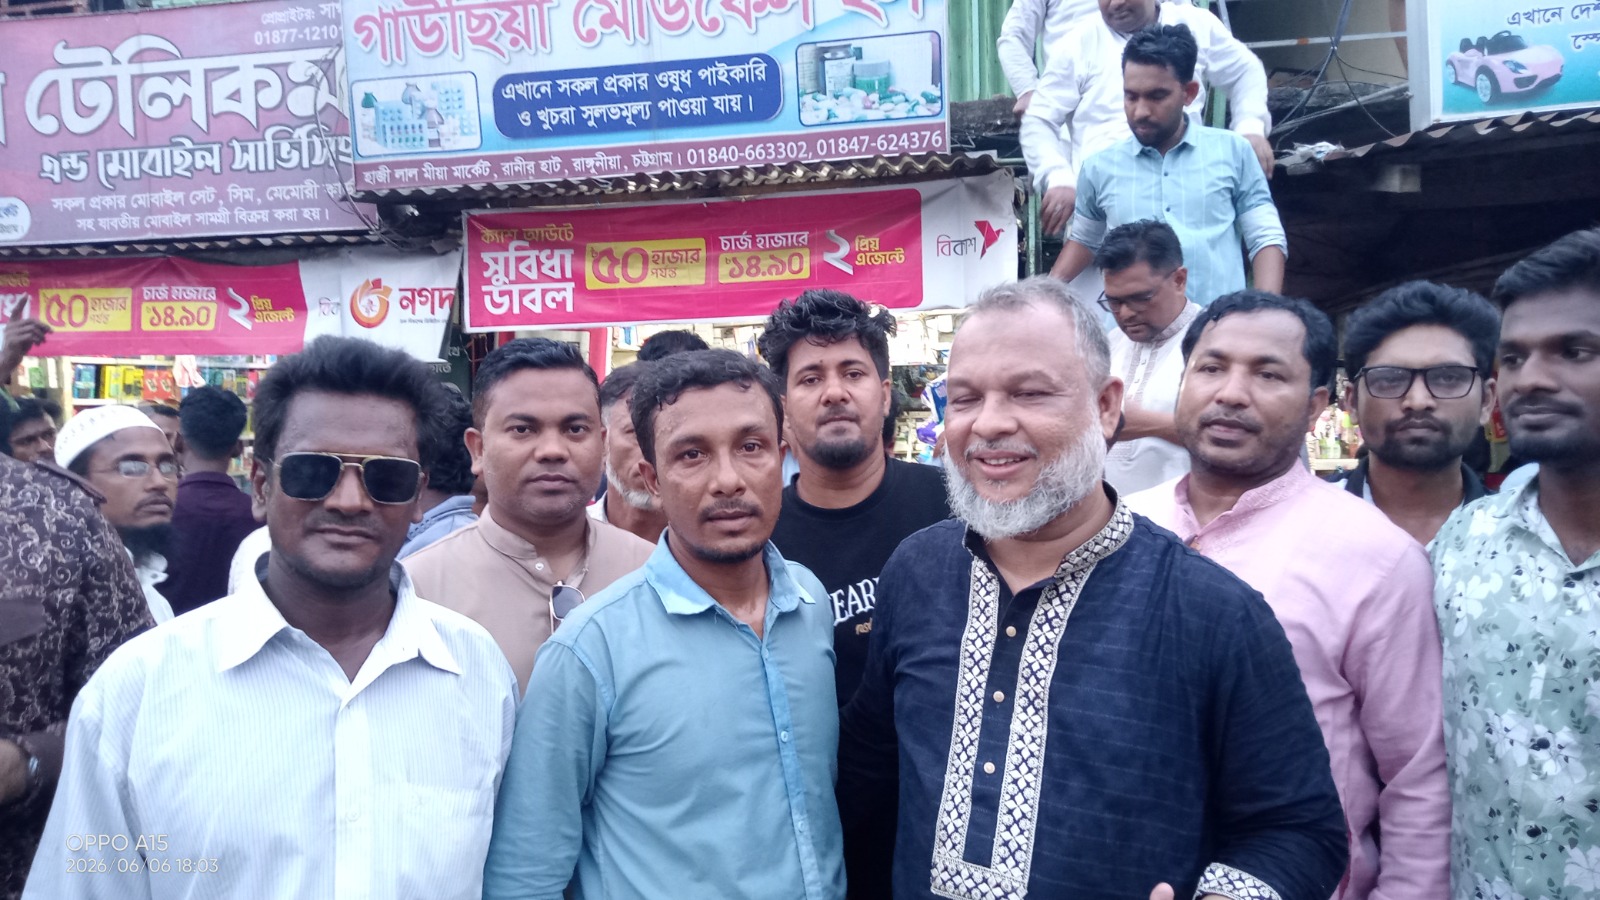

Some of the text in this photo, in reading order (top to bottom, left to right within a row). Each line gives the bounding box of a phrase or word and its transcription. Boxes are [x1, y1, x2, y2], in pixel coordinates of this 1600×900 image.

[1507, 7, 1565, 26] এখানে
[254, 24, 342, 46] 01877-1210
[501, 57, 767, 100] এখানে সকল প্রকার ওষুধ পাইকারি
[517, 111, 531, 126] ও
[536, 105, 576, 131] খুচরা
[579, 101, 652, 128] সুলভমূল্য
[658, 96, 708, 118] পাওয়া
[95, 135, 222, 190] মোবাইল
[363, 165, 392, 185] হাজী
[394, 167, 419, 183] লাল
[421, 161, 448, 181] মীয়া
[501, 155, 536, 176] রানীর
[686, 141, 813, 166] 01840-663302,
[816, 129, 943, 156] 01847-624376
[51, 197, 85, 212] সকল
[89, 194, 126, 211] প্রকার
[130, 188, 185, 209] মোবাইল
[265, 178, 320, 200] মেমোরী
[76, 217, 96, 232] সহ
[99, 211, 140, 231] যাবতীয়
[143, 211, 192, 229] মোবাইল
[195, 206, 231, 226] সামগ্রী
[234, 206, 270, 224] বিক্রয়
[273, 207, 298, 222] করা
[522, 222, 574, 242] আউটে
[718, 231, 809, 250] চার্জ হাজারে
[822, 229, 854, 276] ২
[854, 235, 880, 251] প্রিয়
[936, 235, 977, 258] বিকাশ
[480, 240, 575, 287] সুবিধা
[651, 248, 702, 265] হাজার
[855, 247, 905, 266] এজেন্টে
[142, 285, 217, 301] চার্জ হাজারে
[398, 287, 456, 315] নগদ
[481, 283, 576, 315] ডাবল
[227, 287, 253, 331] ২
